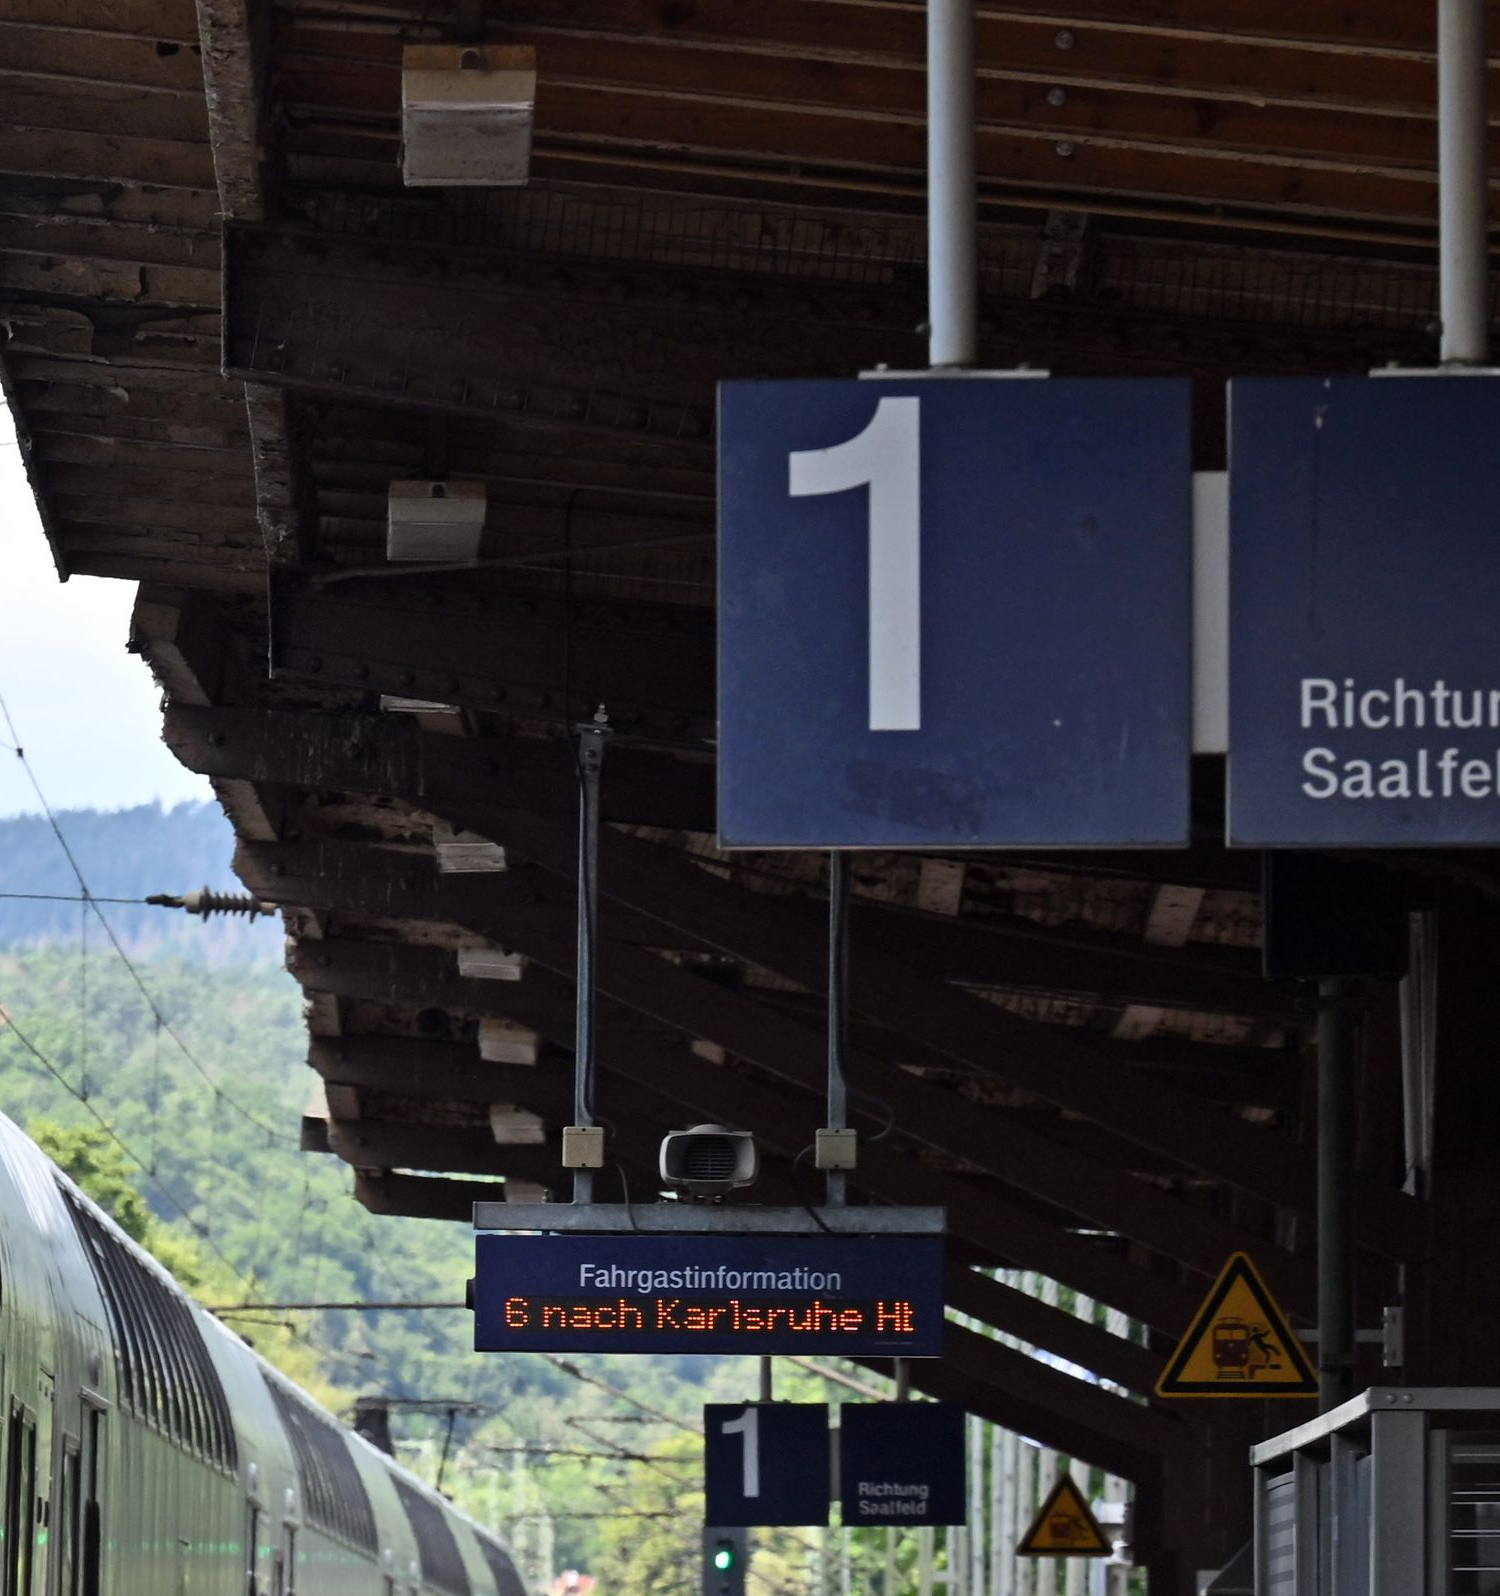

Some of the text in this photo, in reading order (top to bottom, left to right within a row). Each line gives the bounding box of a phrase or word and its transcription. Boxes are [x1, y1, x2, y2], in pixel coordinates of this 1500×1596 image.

[788, 396, 921, 731] 1
[1302, 747, 1500, 799] Saalfe
[579, 1263, 842, 1294] Fahrgastinformation
[505, 1297, 529, 1328] 6
[542, 1300, 643, 1329] nach
[656, 1300, 863, 1331] Karlsruhe
[722, 1407, 759, 1498] 1
[858, 1482, 929, 1500] Richtung
[859, 1501, 928, 1515] Saalfeld
